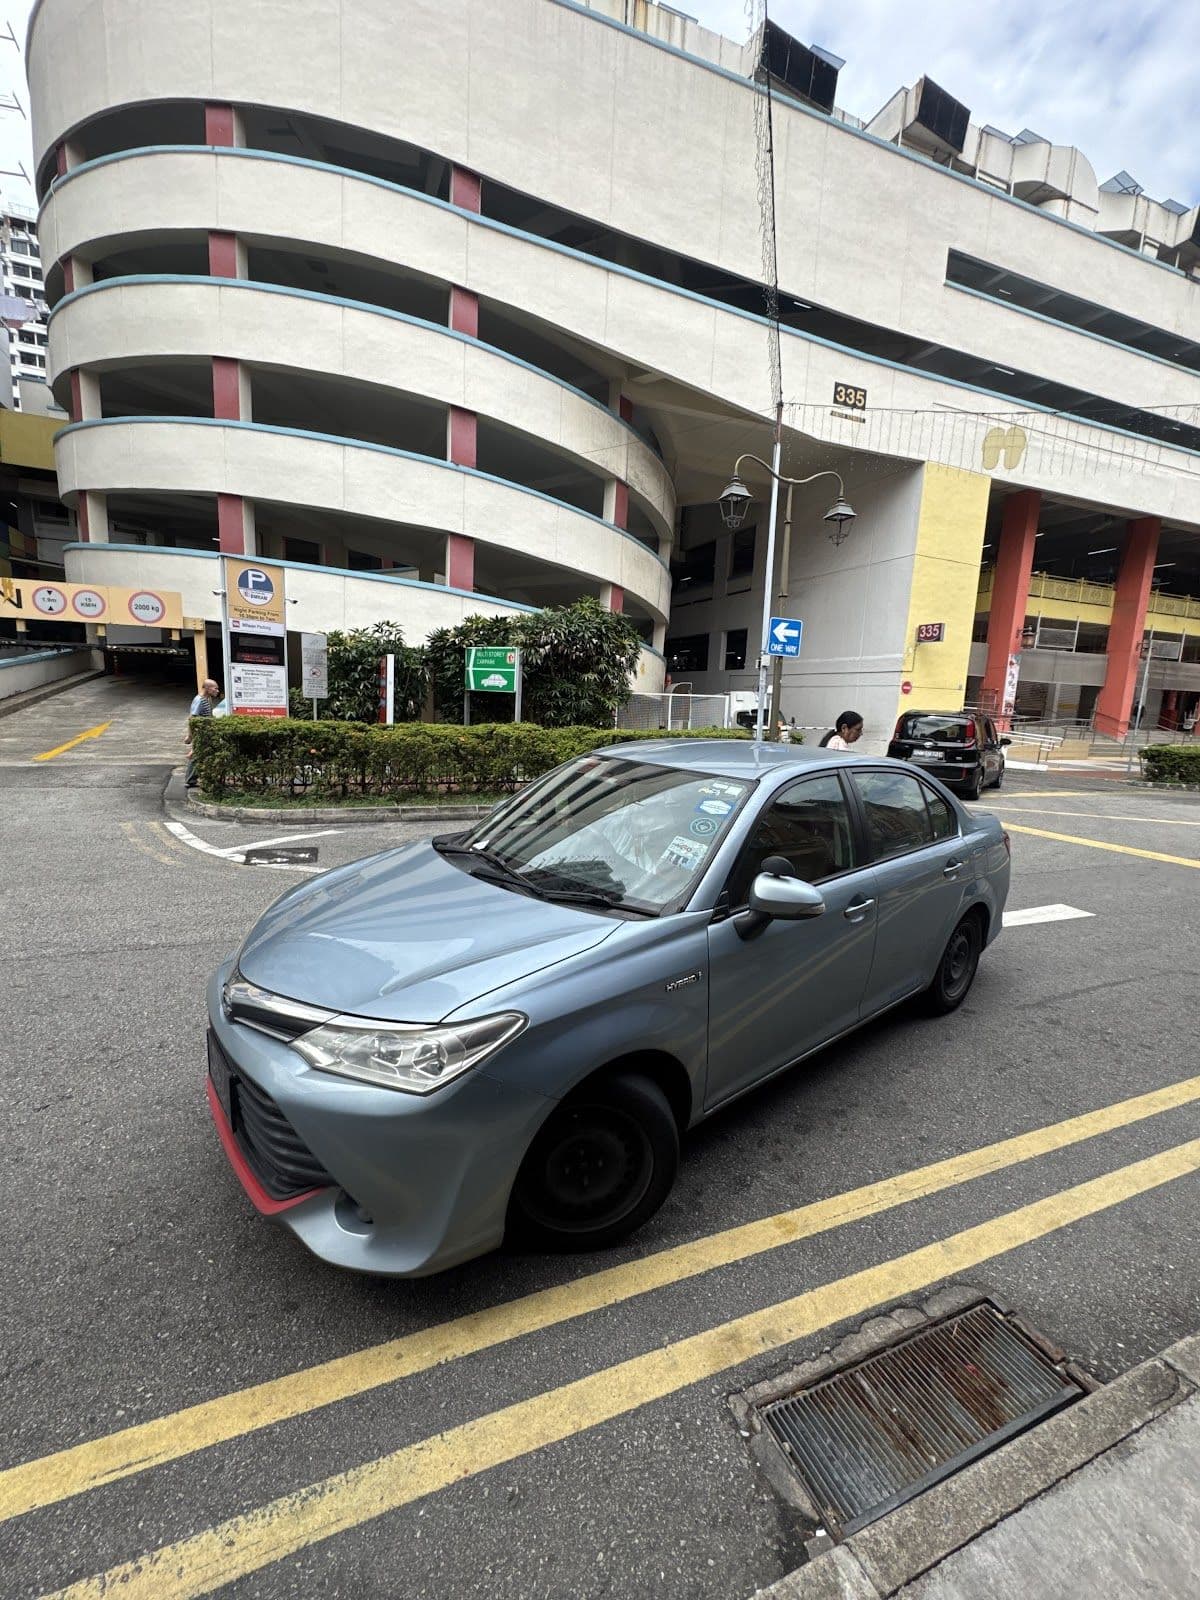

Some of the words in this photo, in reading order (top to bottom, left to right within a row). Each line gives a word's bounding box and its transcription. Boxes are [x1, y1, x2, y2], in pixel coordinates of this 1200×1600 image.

[836, 386, 865, 407] 335
[248, 570, 266, 588] P
[134, 603, 150, 611] 2000
[151, 605, 160, 613] kg
[920, 624, 940, 637] 335
[771, 643, 784, 652] ONE
[786, 645, 798, 653] WAY
